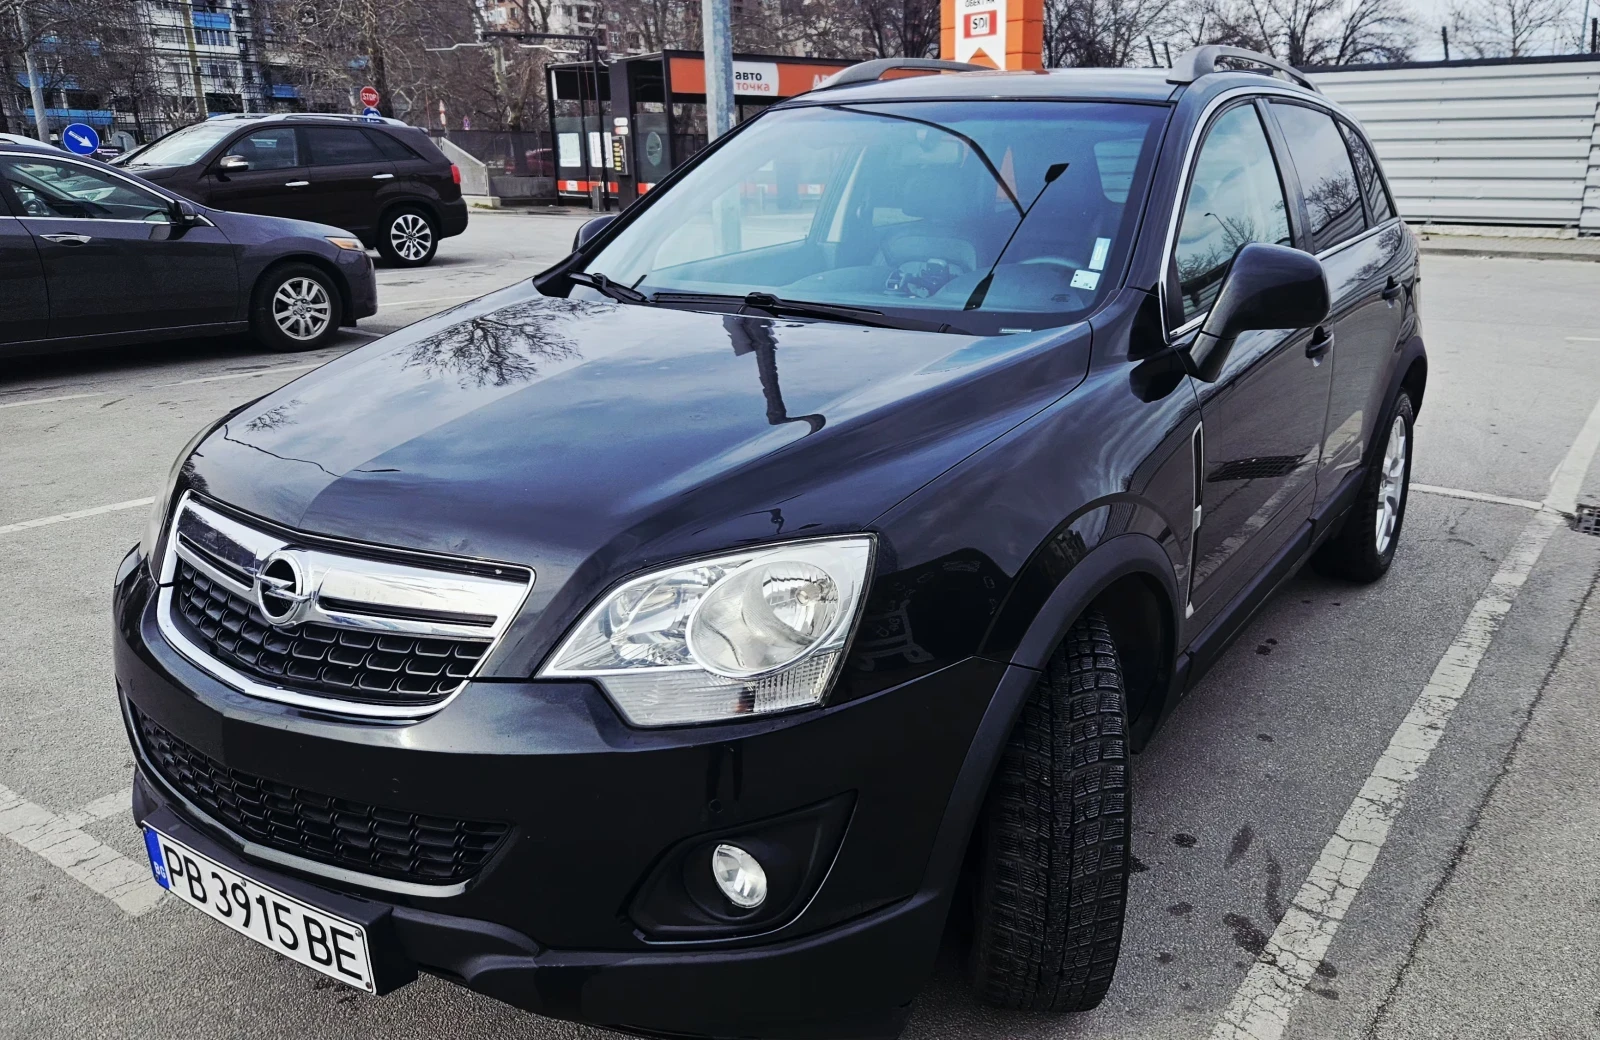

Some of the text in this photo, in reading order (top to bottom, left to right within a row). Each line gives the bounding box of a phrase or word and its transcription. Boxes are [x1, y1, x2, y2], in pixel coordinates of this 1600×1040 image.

[973, 17, 988, 30] SDI
[735, 71, 762, 80] авто
[736, 82, 770, 91] точка
[362, 92, 377, 101] STOP
[154, 861, 166, 879] BG
[163, 844, 362, 981] PB 3915 BE
